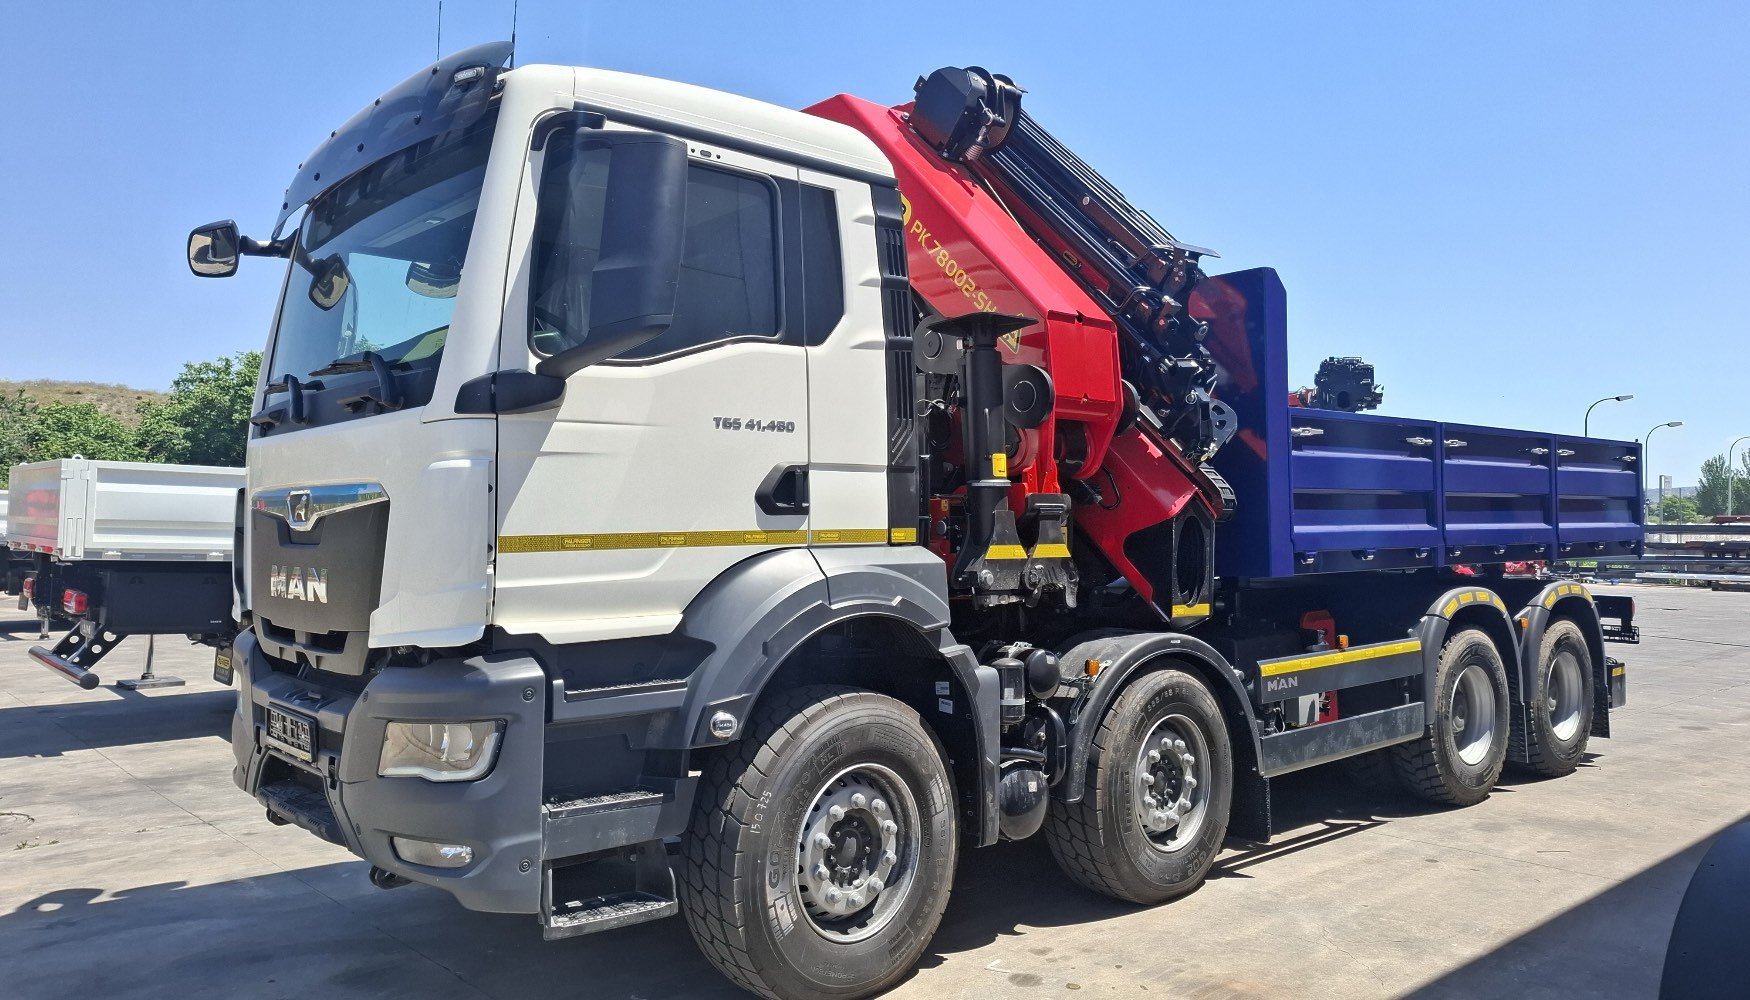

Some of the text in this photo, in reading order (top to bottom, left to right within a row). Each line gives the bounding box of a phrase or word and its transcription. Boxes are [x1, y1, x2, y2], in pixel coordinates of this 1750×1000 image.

[910, 219, 932, 246] PK
[712, 416, 742, 431] TGS
[270, 565, 328, 604] MAN
[1267, 676, 1299, 692] MAN
